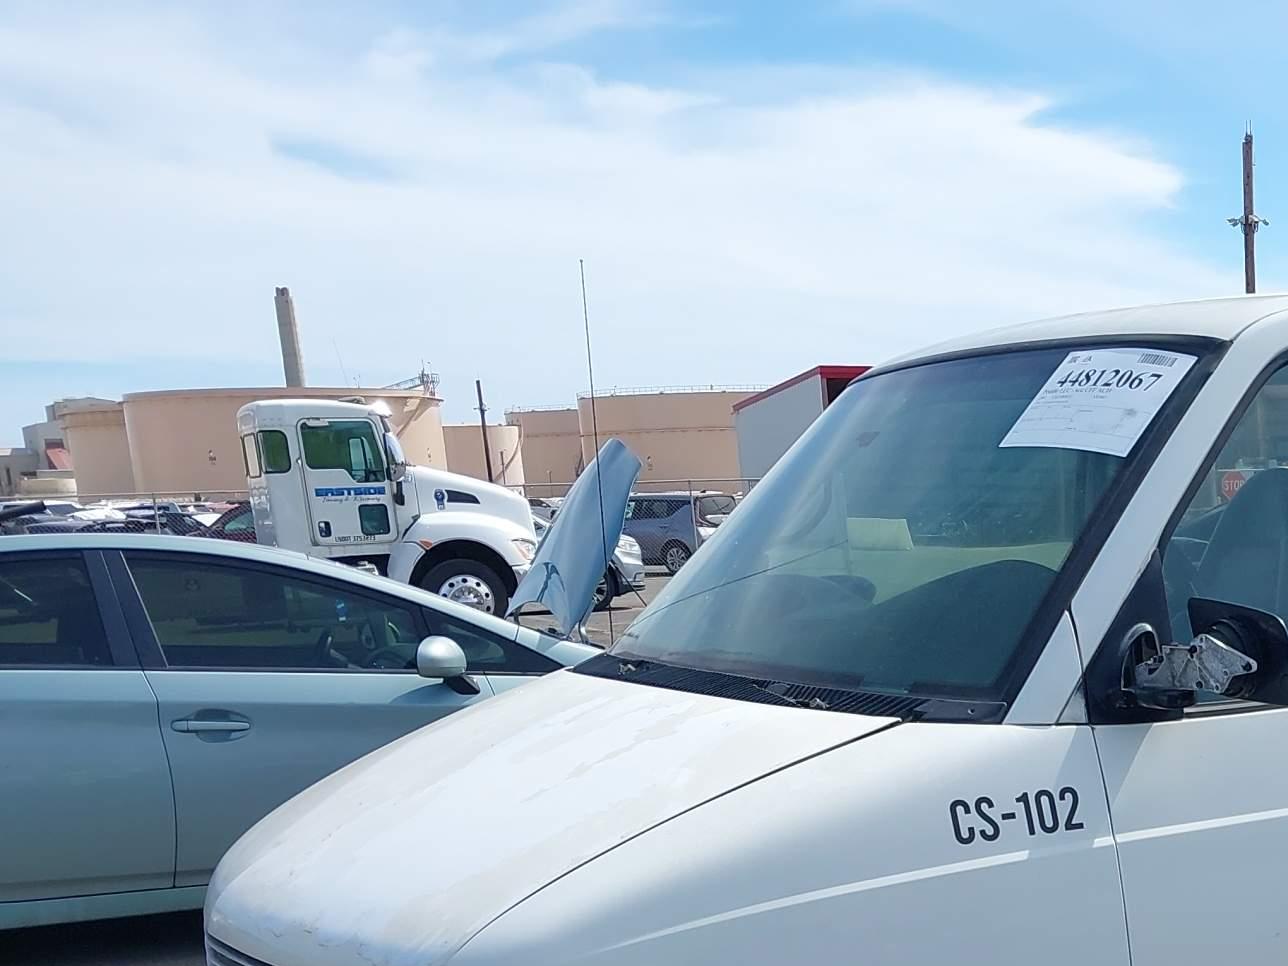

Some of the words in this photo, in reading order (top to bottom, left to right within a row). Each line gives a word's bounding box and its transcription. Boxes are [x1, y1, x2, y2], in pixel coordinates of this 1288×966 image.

[1057, 369, 1163, 392] 44812067
[315, 486, 386, 497] EASTSIDE
[949, 786, 1085, 845] CS-102
